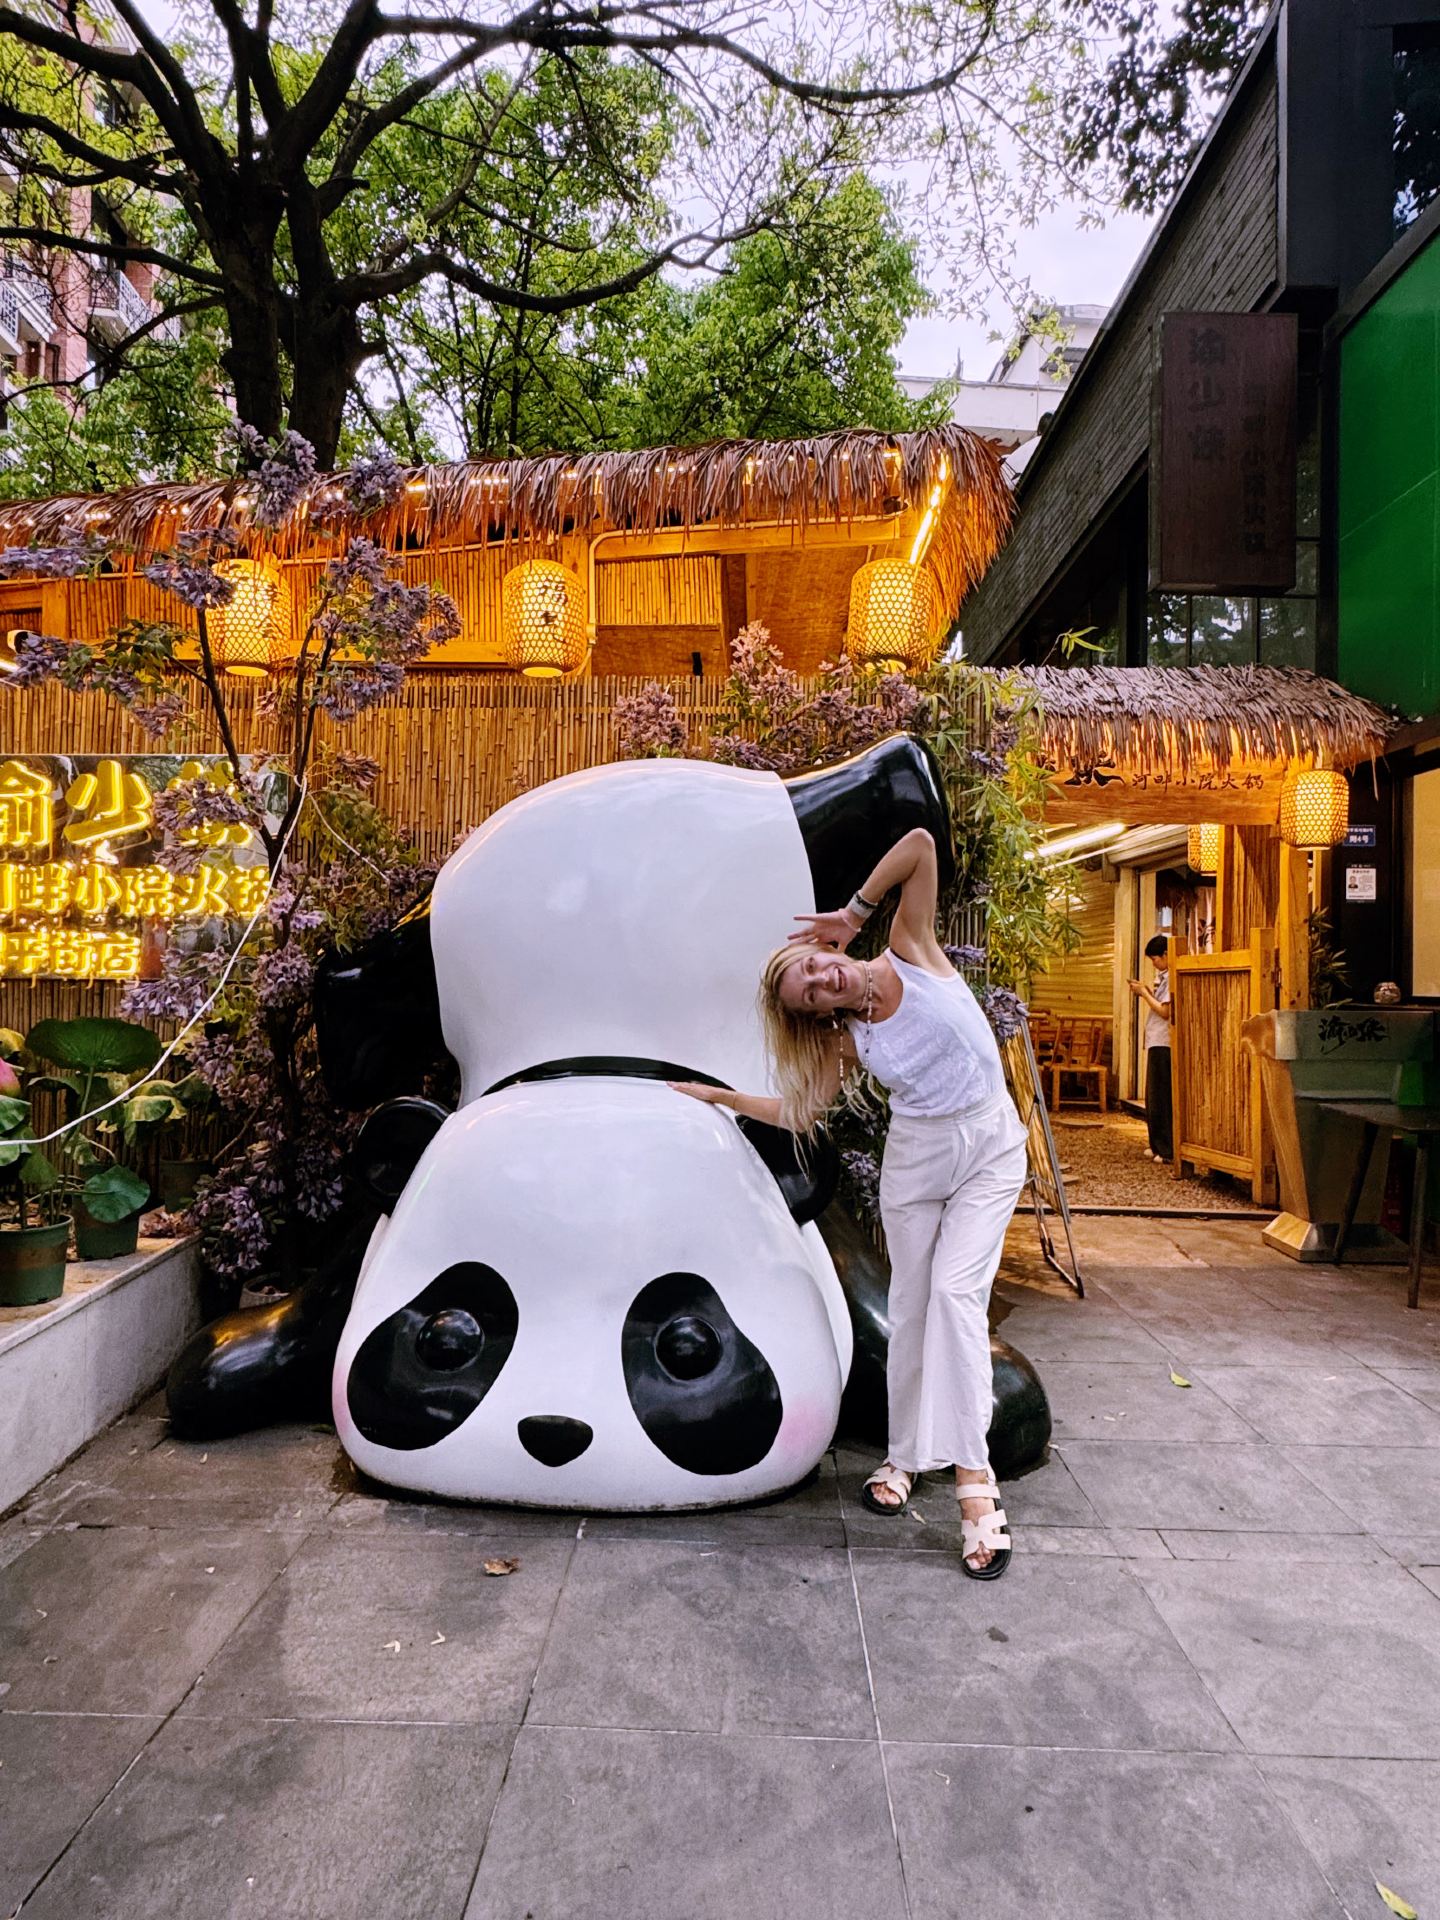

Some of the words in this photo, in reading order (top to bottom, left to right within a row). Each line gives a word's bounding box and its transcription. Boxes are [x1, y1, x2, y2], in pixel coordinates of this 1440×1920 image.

[1132, 771, 1265, 793] 河畔小院火锅
